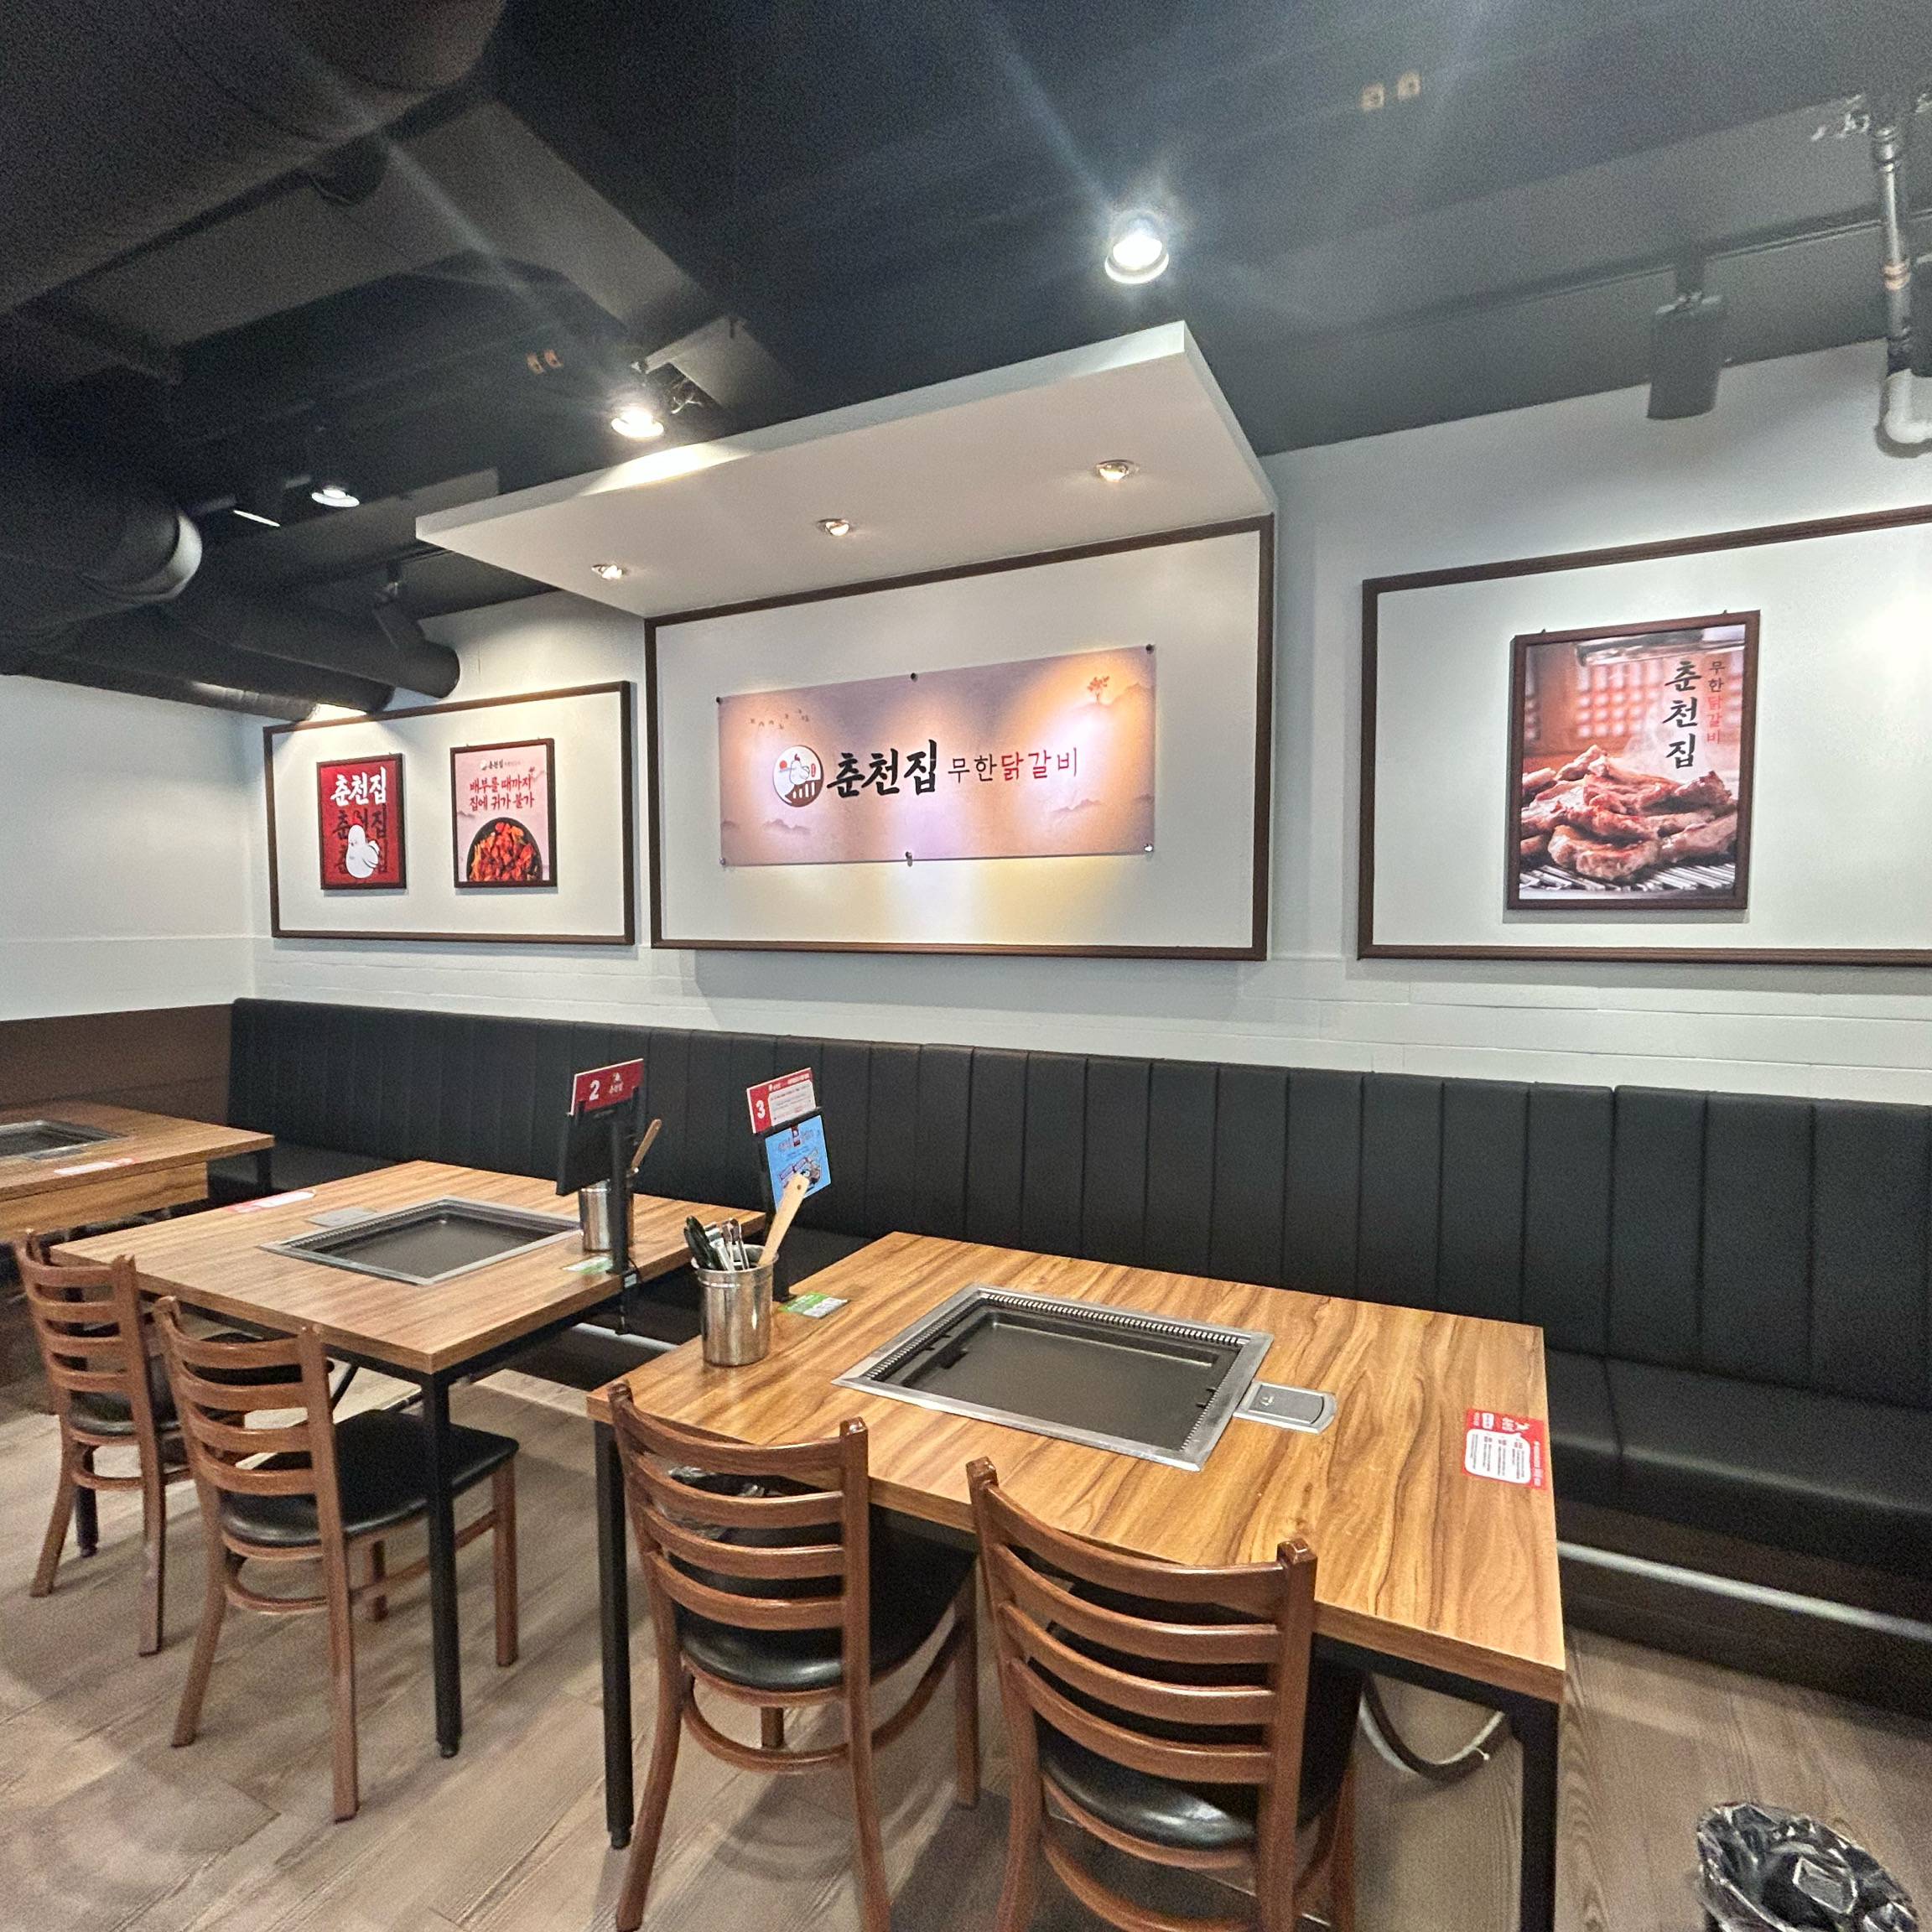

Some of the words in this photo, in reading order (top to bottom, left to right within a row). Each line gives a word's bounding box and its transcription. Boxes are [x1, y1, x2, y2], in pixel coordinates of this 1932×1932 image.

[1661, 660, 1701, 769] 춘천집
[826, 739, 937, 798] 춘천집
[330, 766, 387, 807] 춘천집
[470, 776, 499, 794] 배부를
[501, 773, 532, 792] 때까지
[470, 794, 487, 812] 집에
[491, 792, 511, 811] 귀가
[513, 791, 534, 809] 불가
[589, 1079, 600, 1101] 2
[756, 1099, 766, 1119] 3
